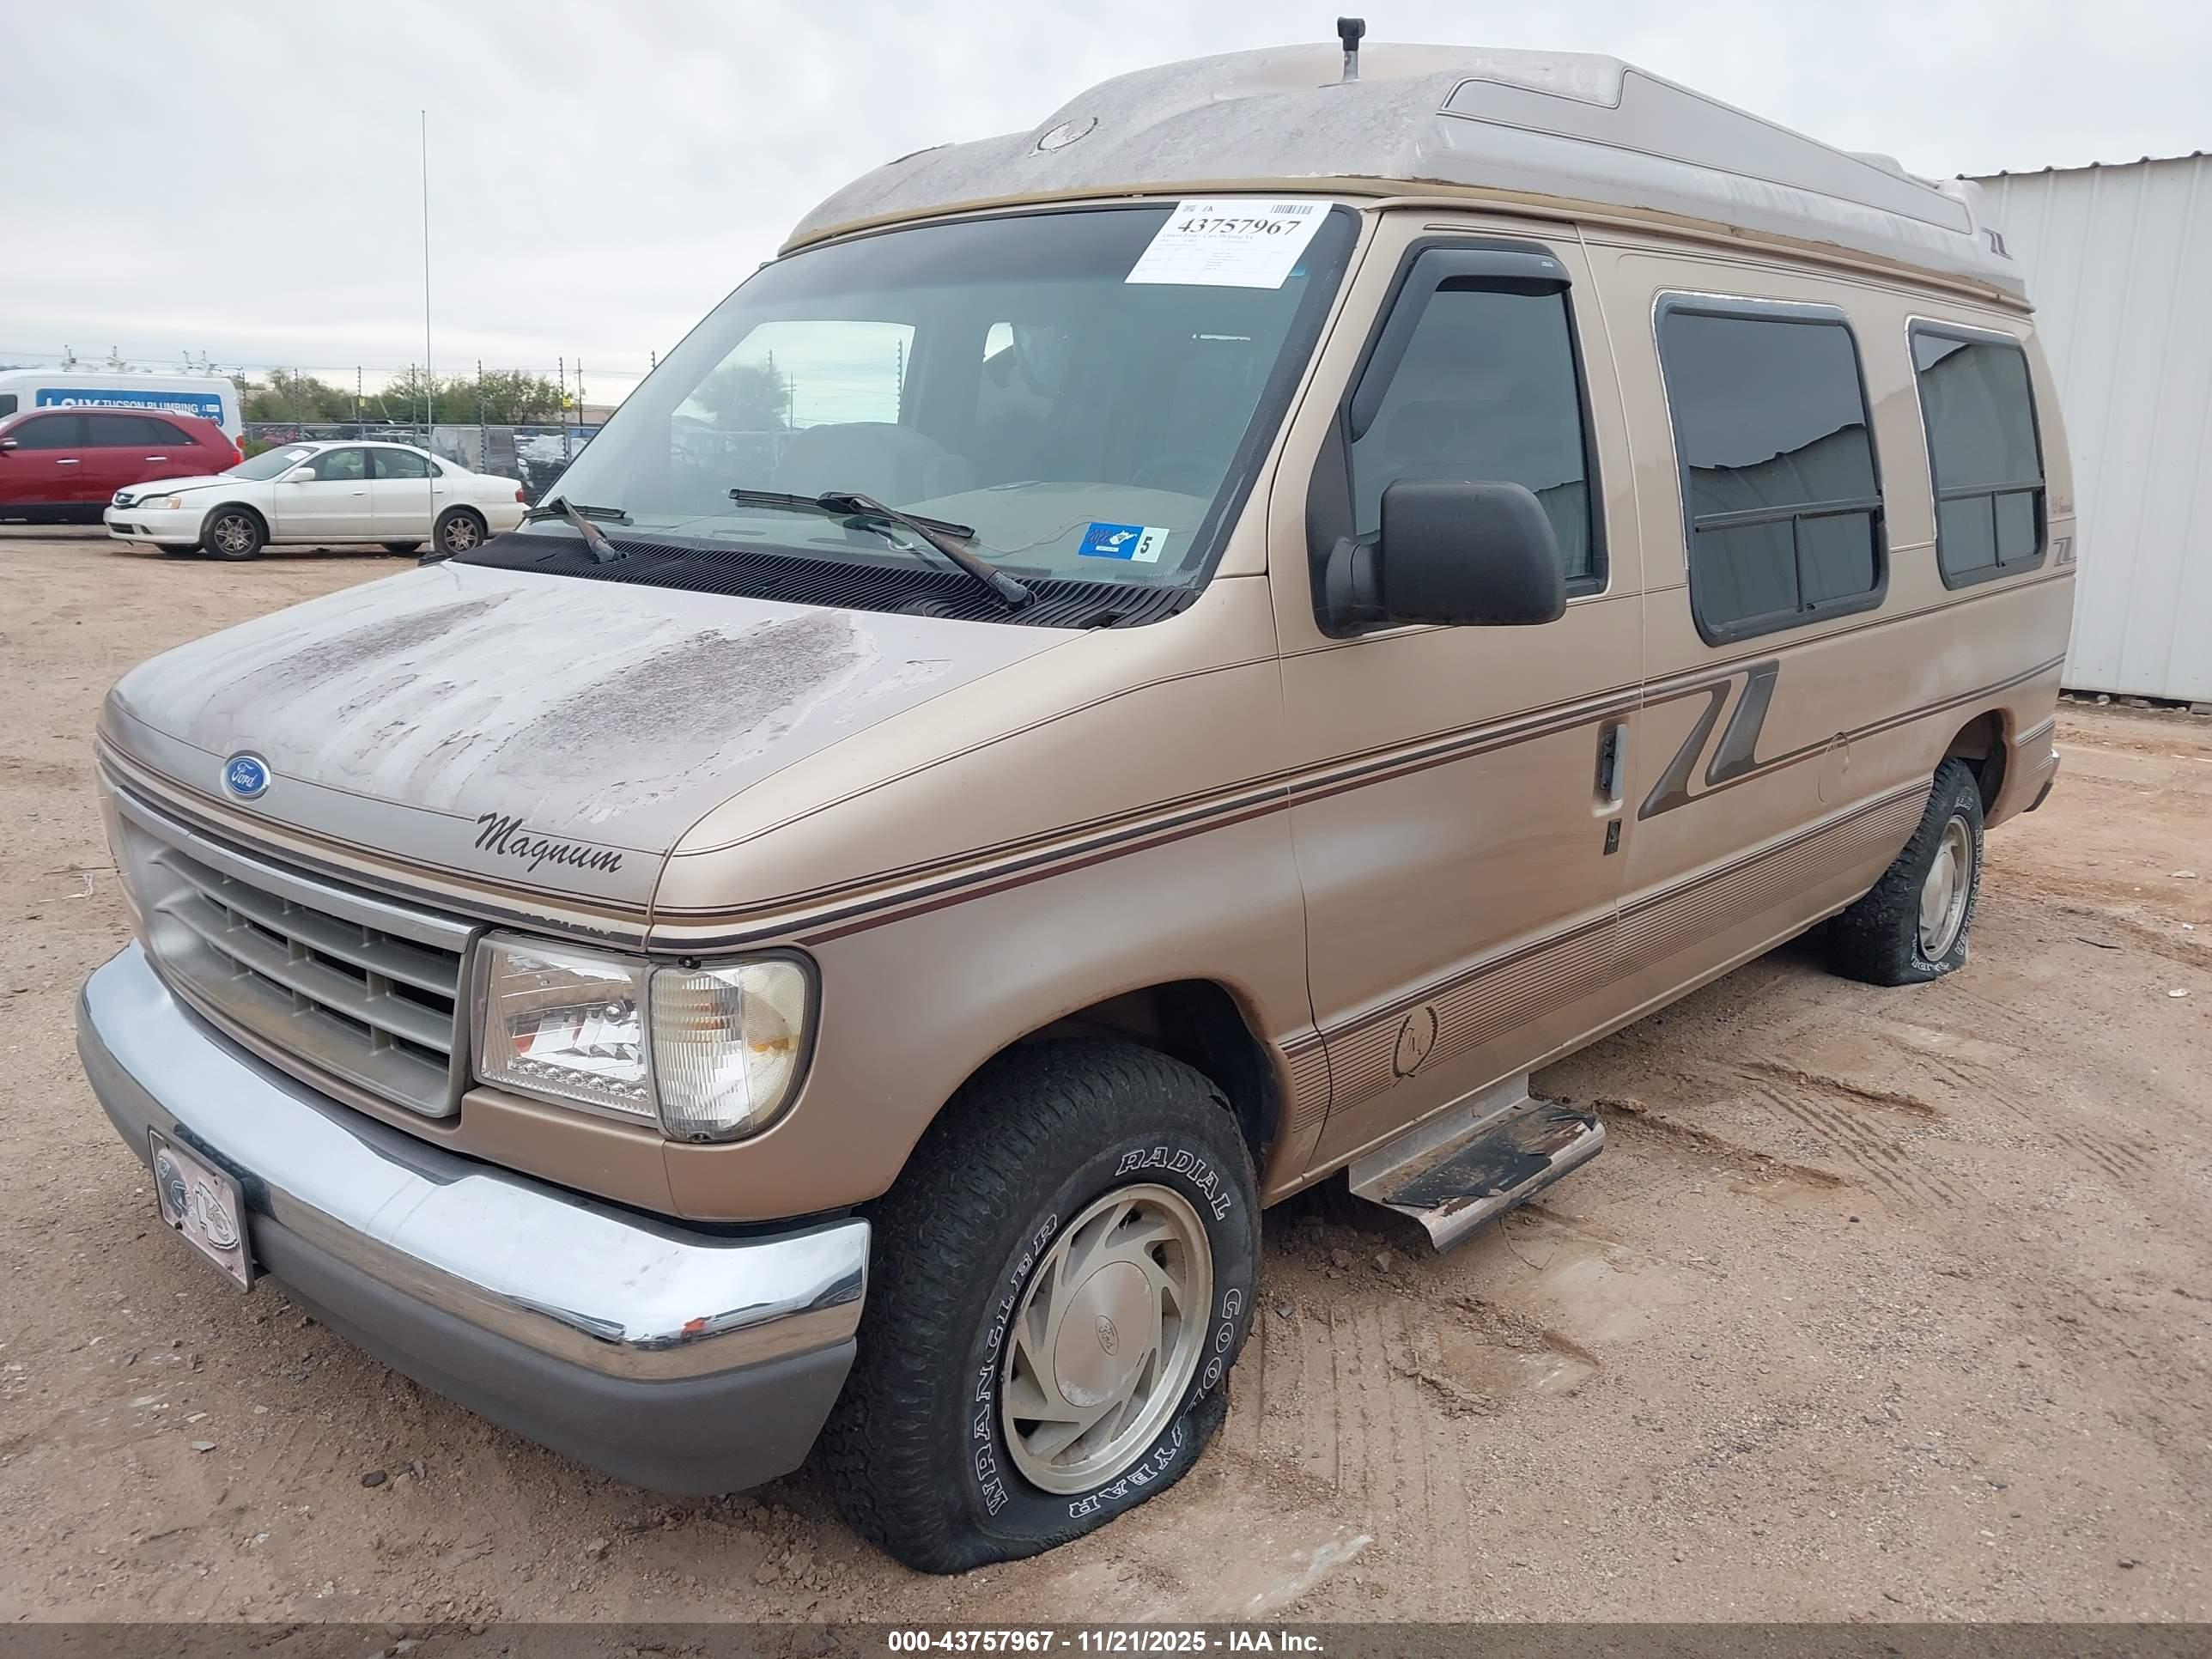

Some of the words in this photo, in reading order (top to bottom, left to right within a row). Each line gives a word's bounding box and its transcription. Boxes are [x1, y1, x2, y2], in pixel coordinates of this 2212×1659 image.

[1177, 217, 1302, 235] 43757967
[1139, 536, 1153, 554] 5
[231, 762, 258, 788] Ford
[473, 811, 624, 873] Magnum
[1114, 1146, 1231, 1221] RADIAL
[974, 1213, 1058, 1517] WRANGLER
